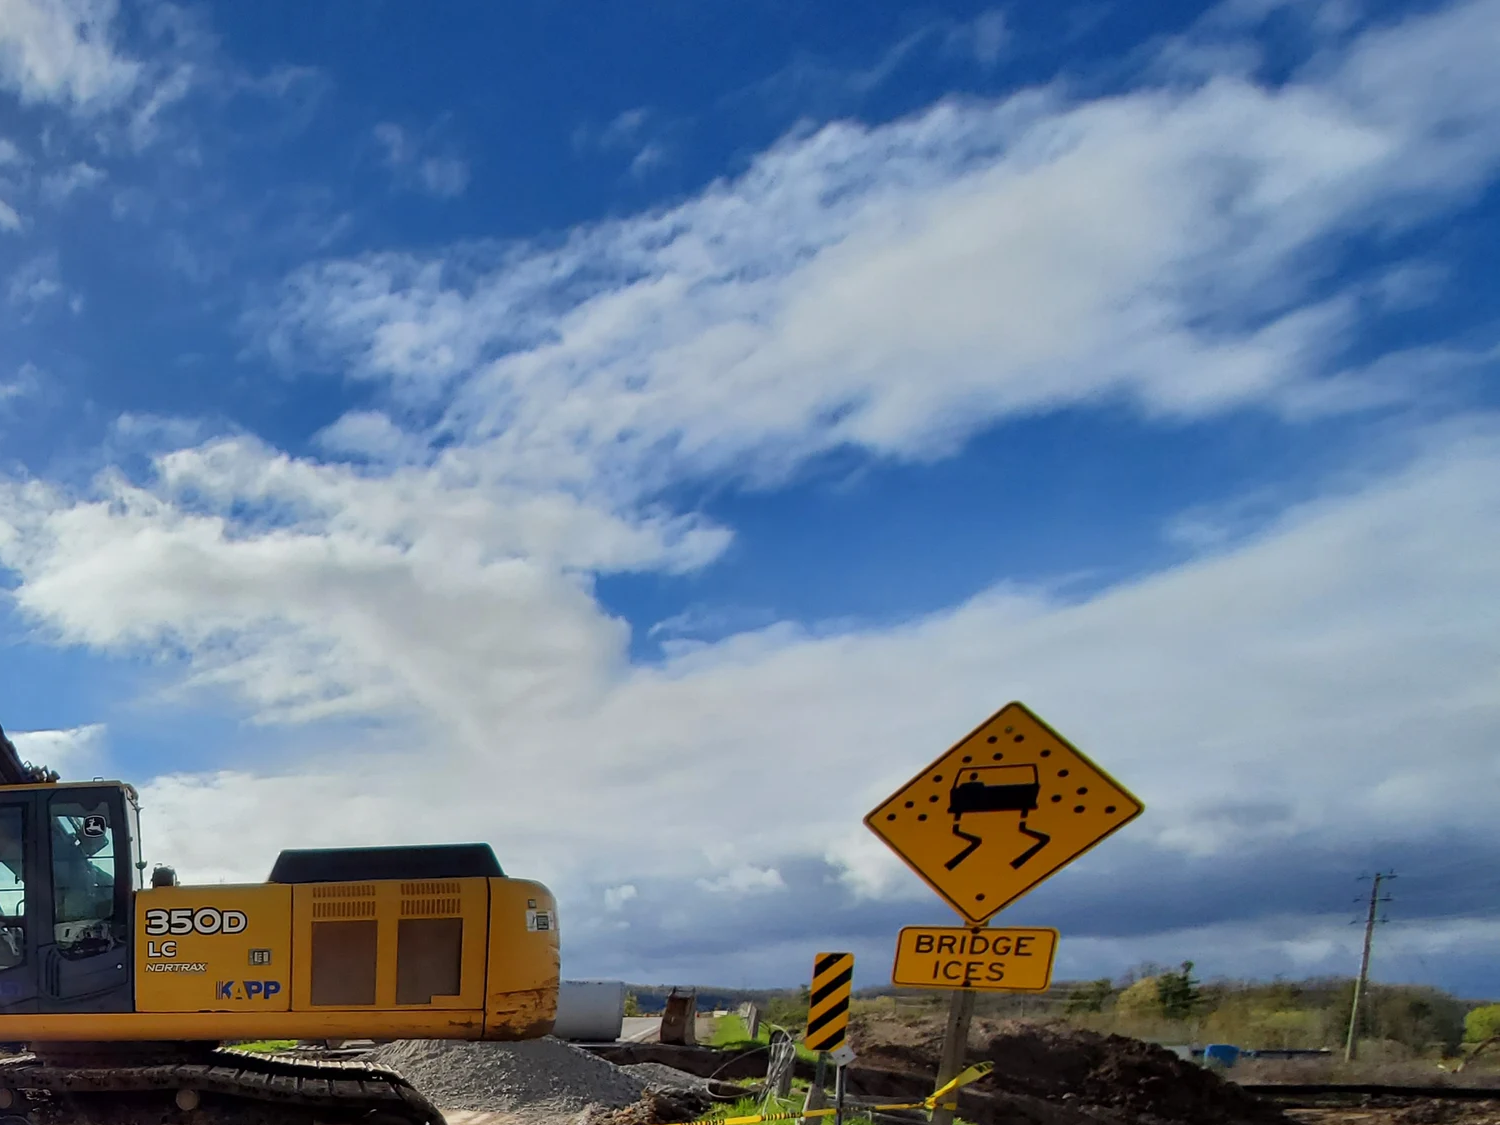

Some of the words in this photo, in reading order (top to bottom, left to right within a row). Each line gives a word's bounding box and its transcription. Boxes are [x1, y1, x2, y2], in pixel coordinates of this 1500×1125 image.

[145, 907, 248, 936] 350D
[147, 941, 177, 958] LC
[915, 934, 1036, 956] BRIDGE
[145, 963, 208, 973] NORTRAX
[932, 960, 1006, 982] ICES
[215, 981, 281, 1000] KAPP
